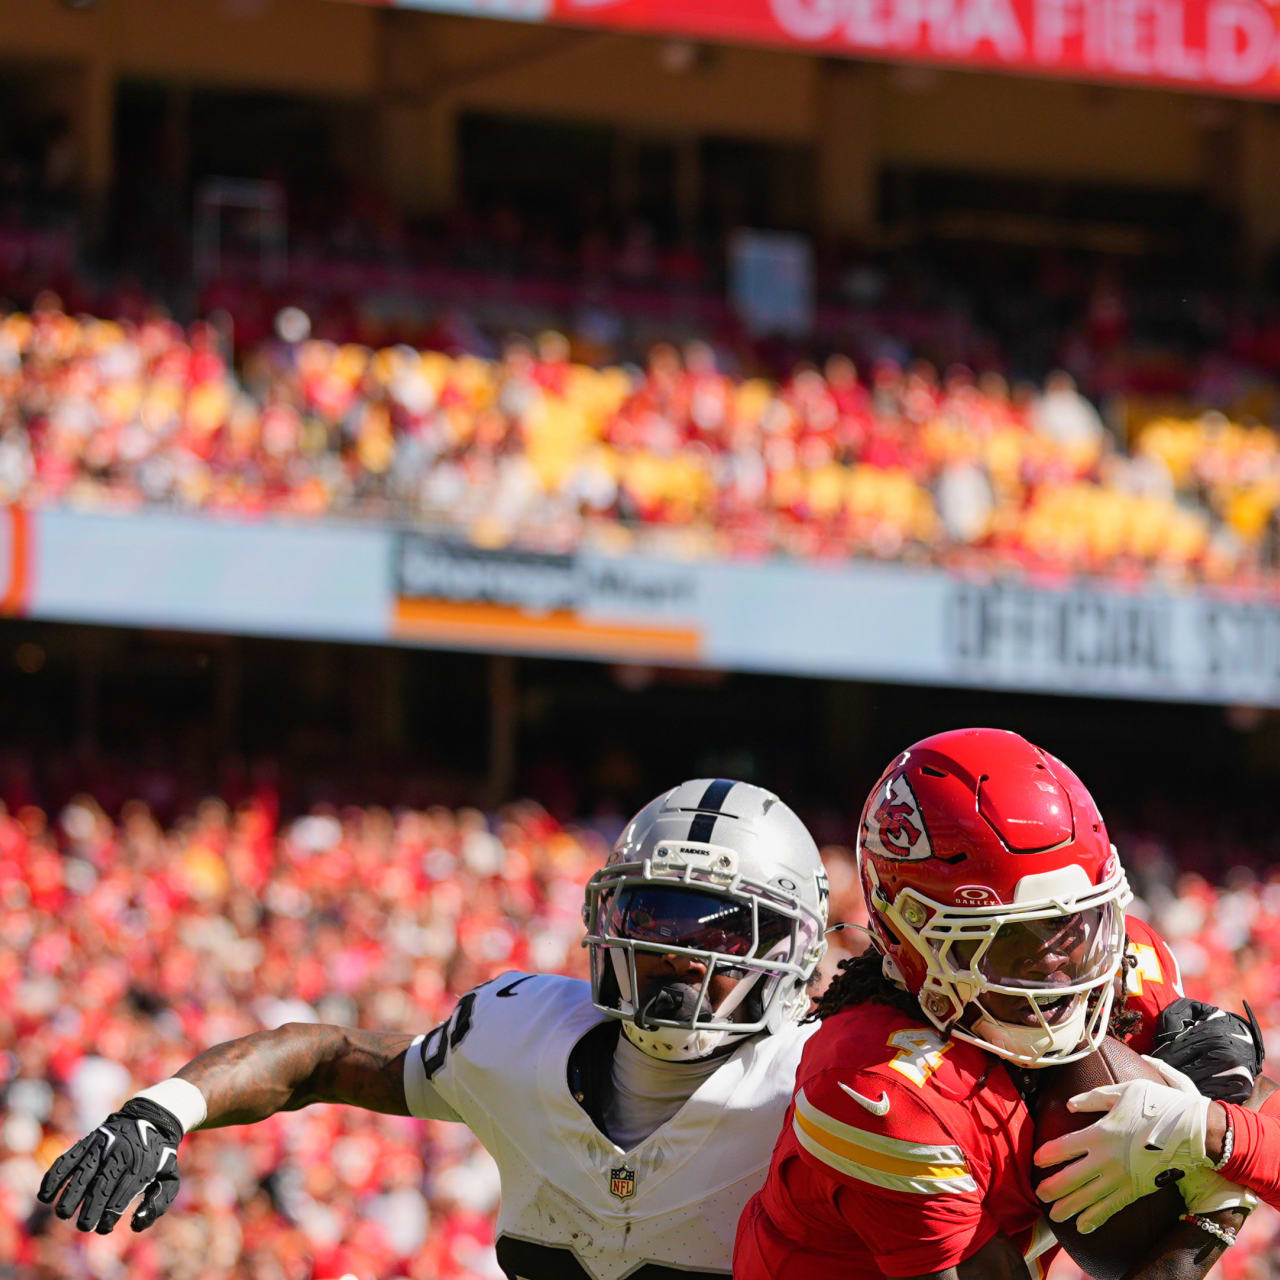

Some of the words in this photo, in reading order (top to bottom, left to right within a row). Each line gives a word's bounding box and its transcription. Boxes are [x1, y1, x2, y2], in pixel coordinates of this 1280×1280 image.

[1033, 0, 1275, 86] FIELD
[949, 580, 1170, 671] OFFICIAL
[679, 847, 711, 857] RAIDERS
[955, 898, 997, 906] OAKLEY
[613, 1179, 632, 1196] NFL
